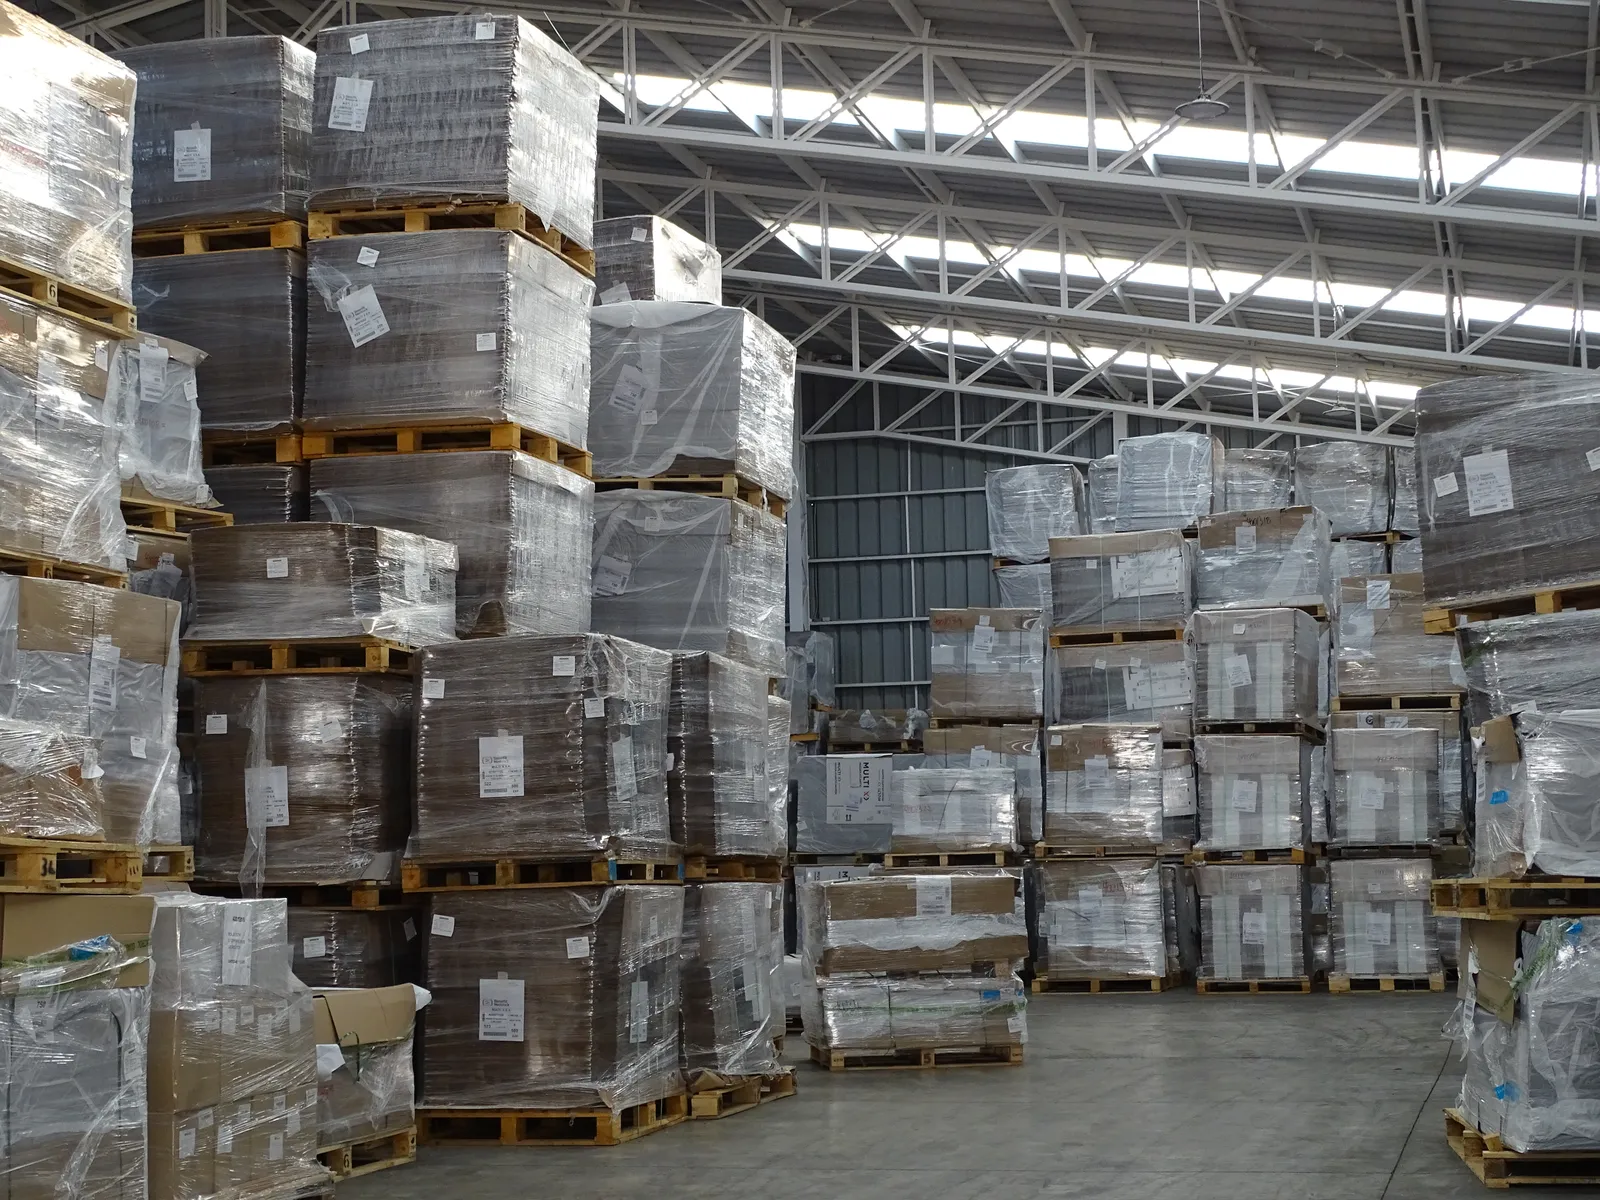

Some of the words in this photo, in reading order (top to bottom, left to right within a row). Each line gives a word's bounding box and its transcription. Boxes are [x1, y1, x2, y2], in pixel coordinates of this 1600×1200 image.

[49, 284, 56, 298] 6
[862, 762, 870, 788] MULTI
[922, 1051, 932, 1064] 5
[343, 1153, 350, 1168] 6
